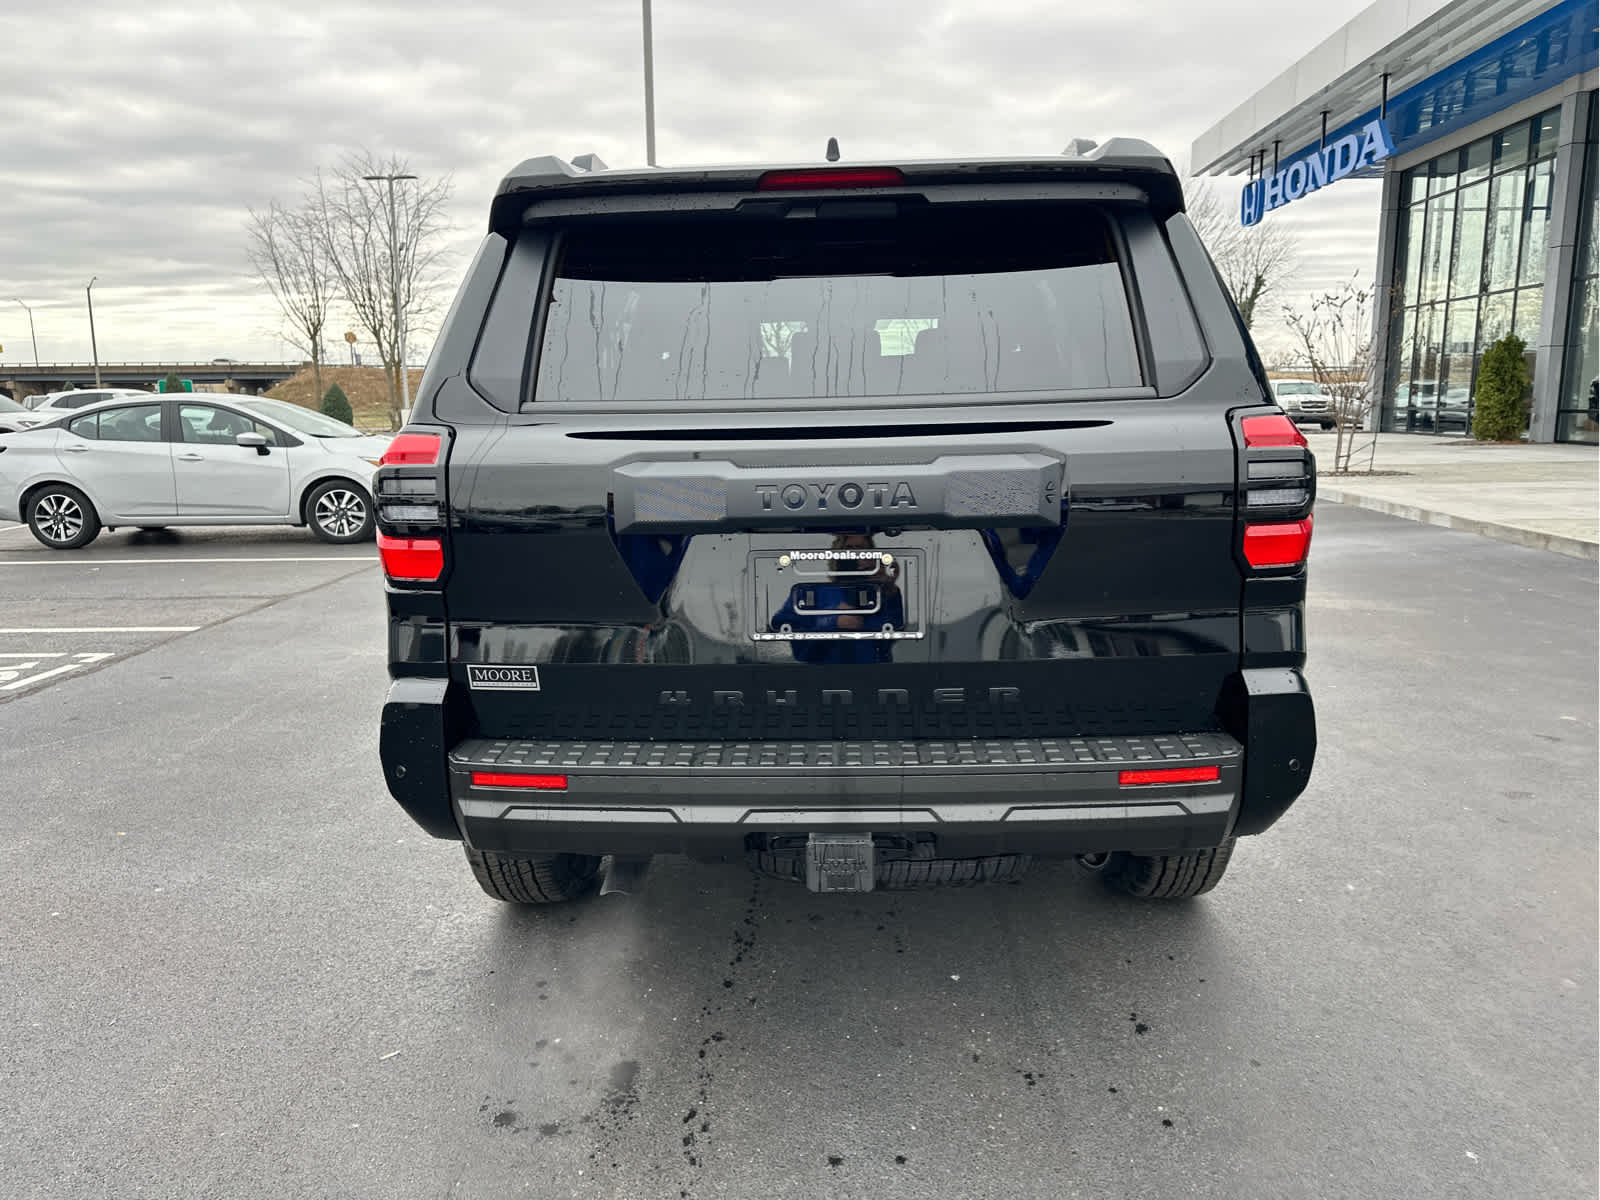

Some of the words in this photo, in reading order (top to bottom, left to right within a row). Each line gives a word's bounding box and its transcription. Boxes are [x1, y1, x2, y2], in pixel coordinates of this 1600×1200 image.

[1263, 119, 1392, 212] HONDA
[754, 482, 918, 511] TOYOTA
[790, 550, 882, 560] MooreDeals.com
[474, 669, 532, 681] MOORE
